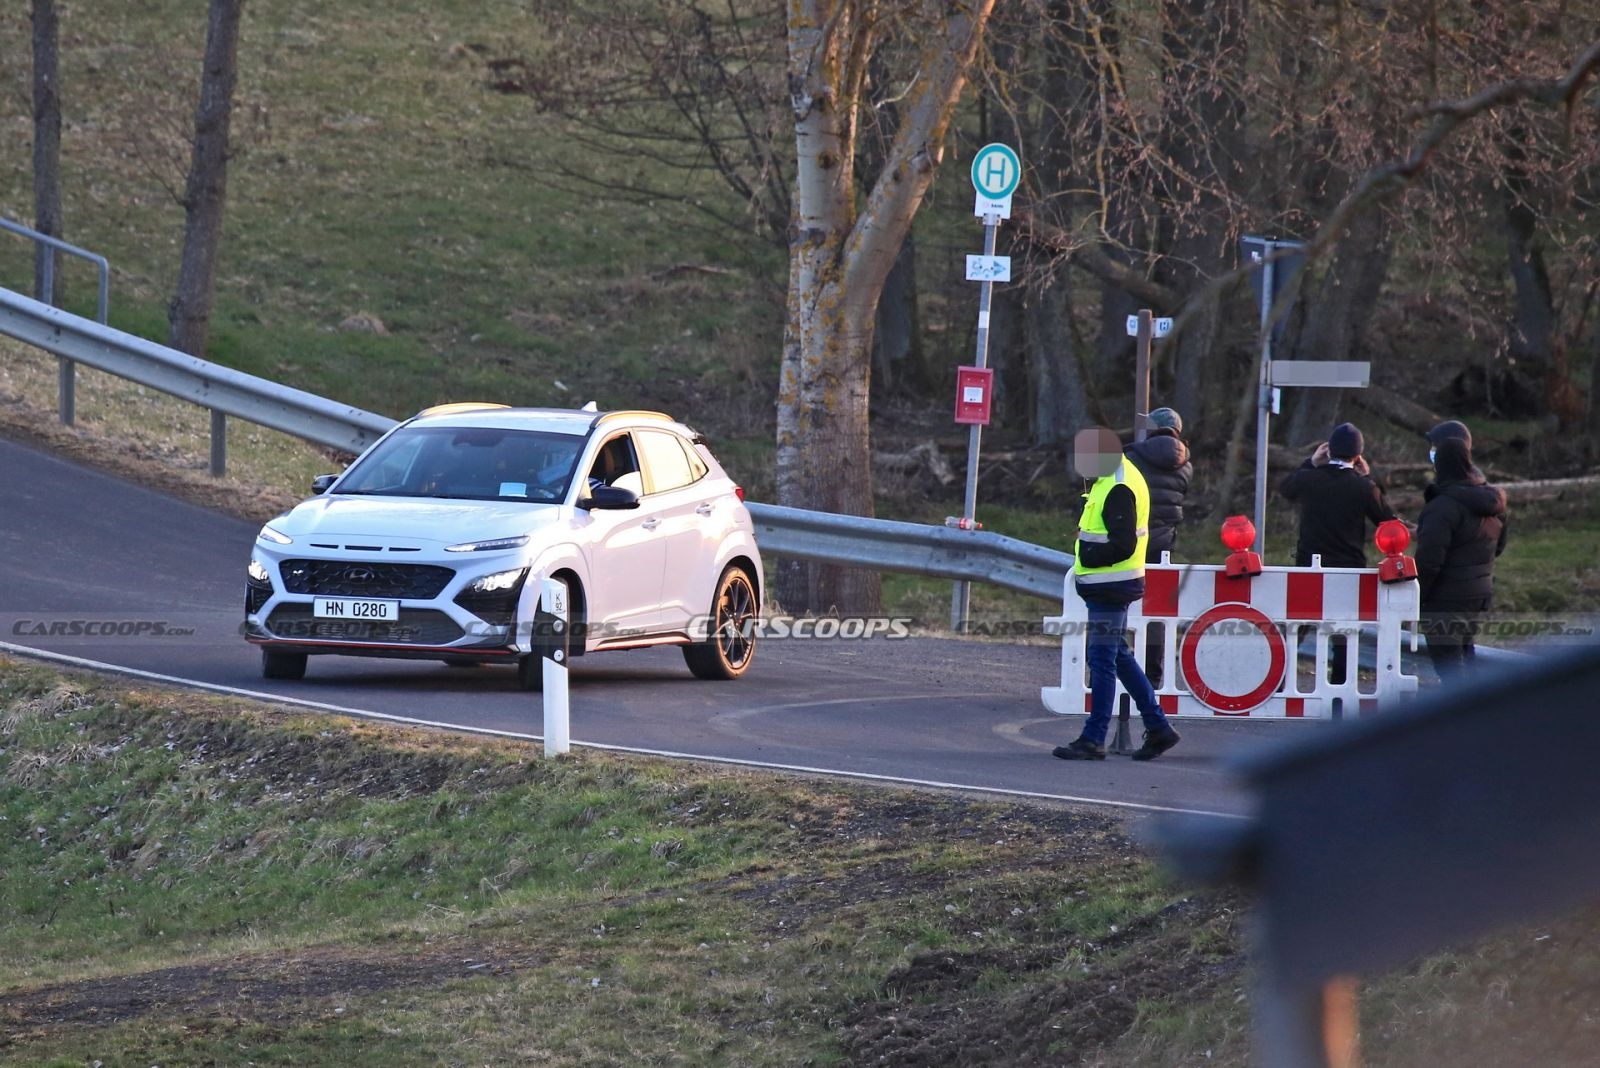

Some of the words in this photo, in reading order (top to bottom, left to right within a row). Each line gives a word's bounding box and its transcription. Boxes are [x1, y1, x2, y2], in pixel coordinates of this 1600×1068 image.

[985, 156, 1006, 188] H
[325, 601, 344, 616] HN
[352, 602, 387, 618] 0280
